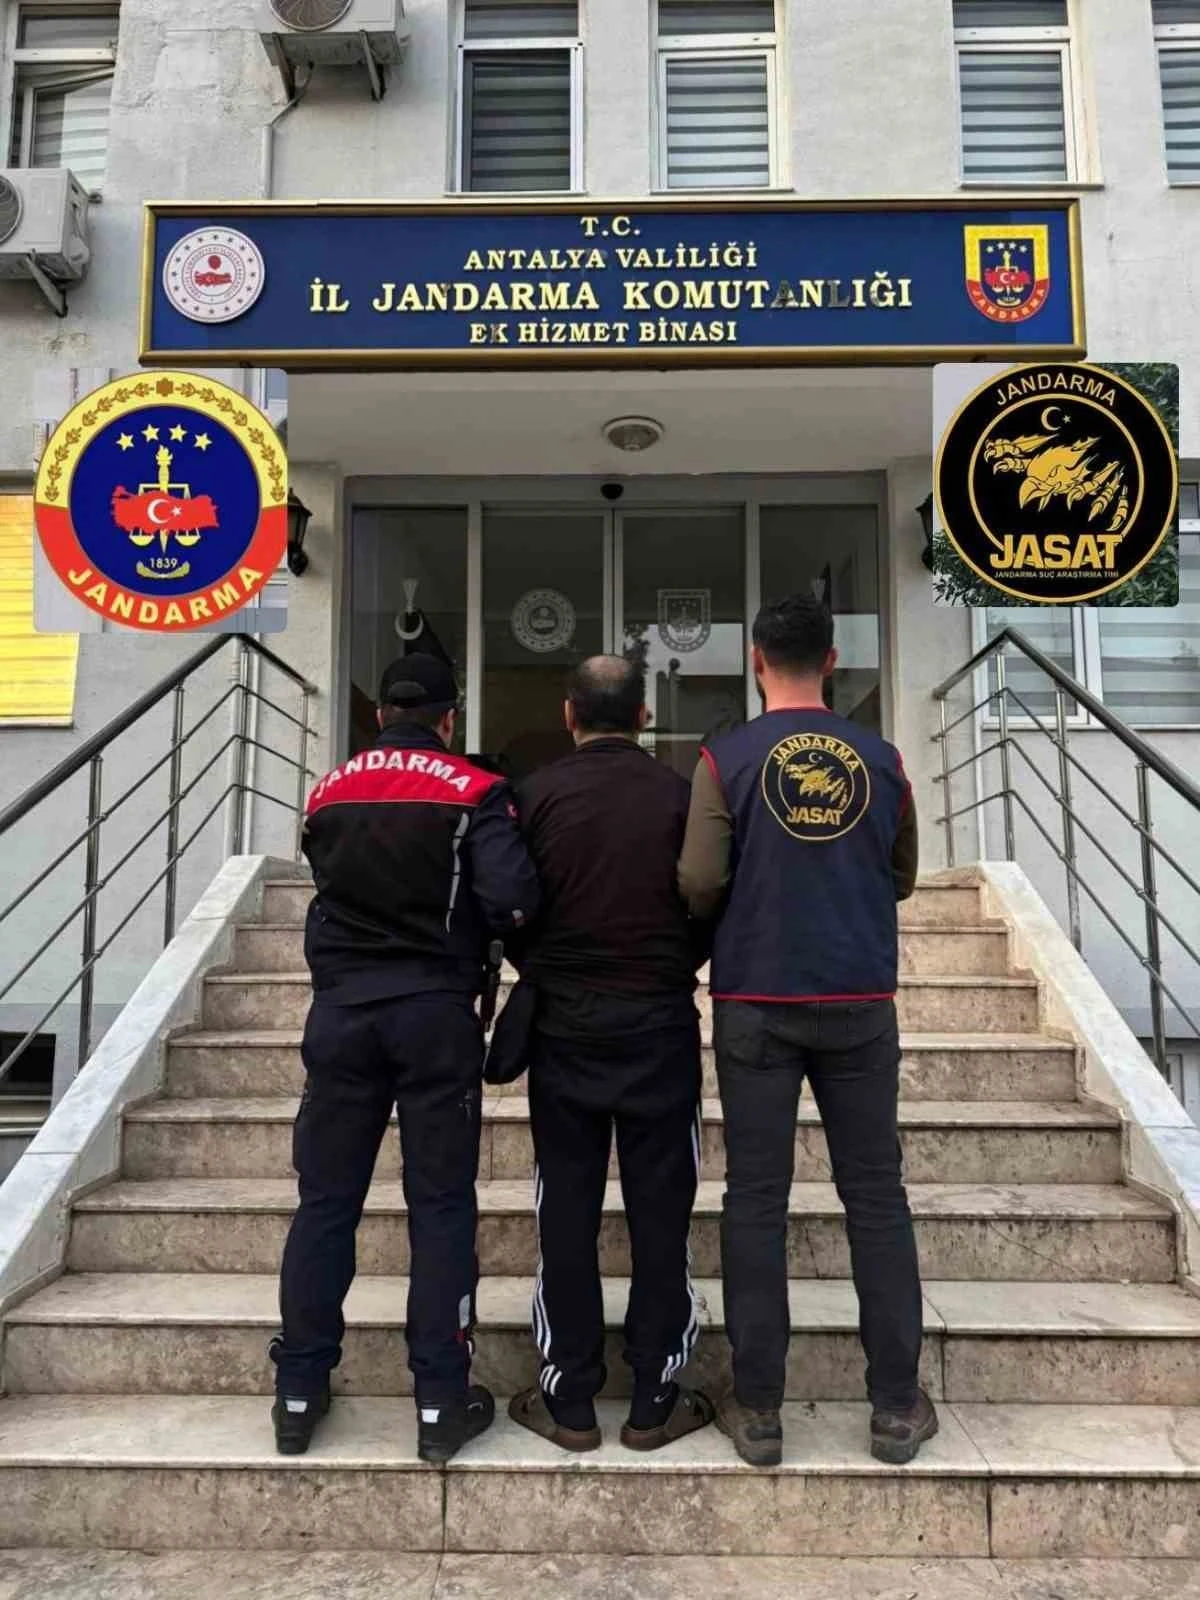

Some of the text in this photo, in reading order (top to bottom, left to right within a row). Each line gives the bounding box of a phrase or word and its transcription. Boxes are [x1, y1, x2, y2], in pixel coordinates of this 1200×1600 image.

[580, 216, 641, 237] T.C.
[463, 241, 758, 271] ANTALYA VALİLİĞİ
[309, 271, 913, 312] İL JANDARMA KOMUTANLIĞI
[469, 316, 737, 343] EK HİZMET BİNASI
[773, 736, 860, 772] JANDARMA
[314, 750, 473, 799] JANDARMA
[785, 805, 841, 826] JASAT
